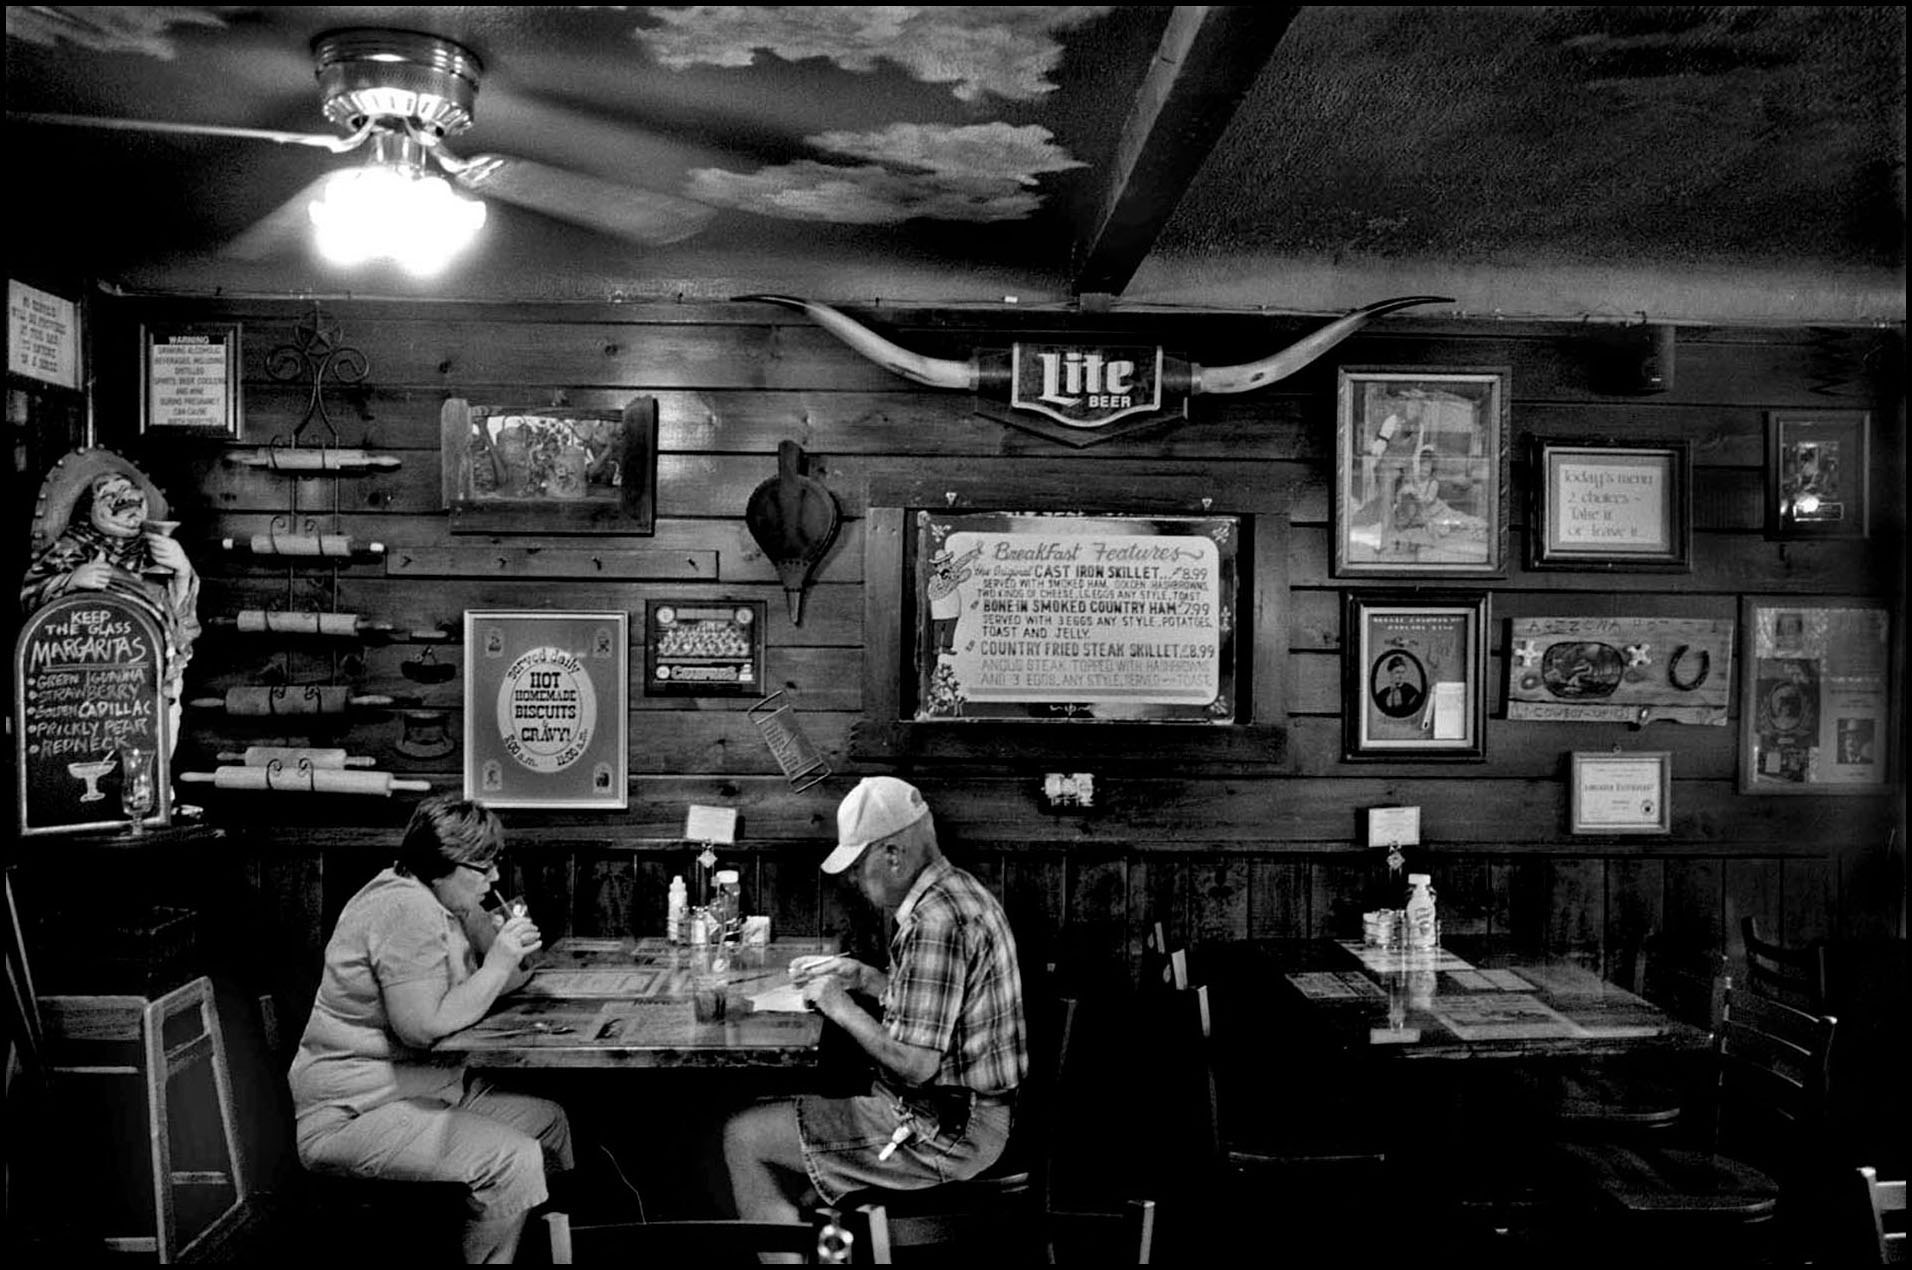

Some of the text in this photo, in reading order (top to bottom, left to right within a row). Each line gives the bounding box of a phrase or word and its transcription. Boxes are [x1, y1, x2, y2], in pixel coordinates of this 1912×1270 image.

[169, 336, 210, 345] WARNING
[1038, 353, 1135, 407] Lite
[1089, 395, 1131, 408] BEER
[1091, 542, 1184, 562] Features
[1034, 565, 1070, 578] CAST
[1076, 565, 1104, 579] IRON
[1032, 600, 1086, 613] SMOKED
[1090, 600, 1145, 614] COUNTRY
[71, 610, 111, 624] KEEP
[983, 614, 1021, 625] SERVED
[1026, 615, 1052, 625] WITH
[1097, 616, 1117, 626] ANY
[44, 621, 132, 637] THE GLASS
[983, 626, 1017, 638] TOAST
[1023, 627, 1048, 639] AND
[30, 636, 147, 673] MARGARITAS
[981, 641, 1041, 656] COUNTRY
[1045, 641, 1080, 656] FRIED
[1083, 642, 1125, 657] STEAK
[1026, 659, 1064, 672] STEAK
[529, 671, 561, 689] HOT
[980, 673, 1006, 686] AND
[38, 683, 140, 702] STRAWBERRY
[514, 689, 577, 702] HOMEMADE
[78, 700, 151, 718] CADILLAC
[514, 705, 577, 719] BISCUITS
[37, 717, 148, 737] PRICKLY PEAR
[41, 735, 132, 760] REDNECK
